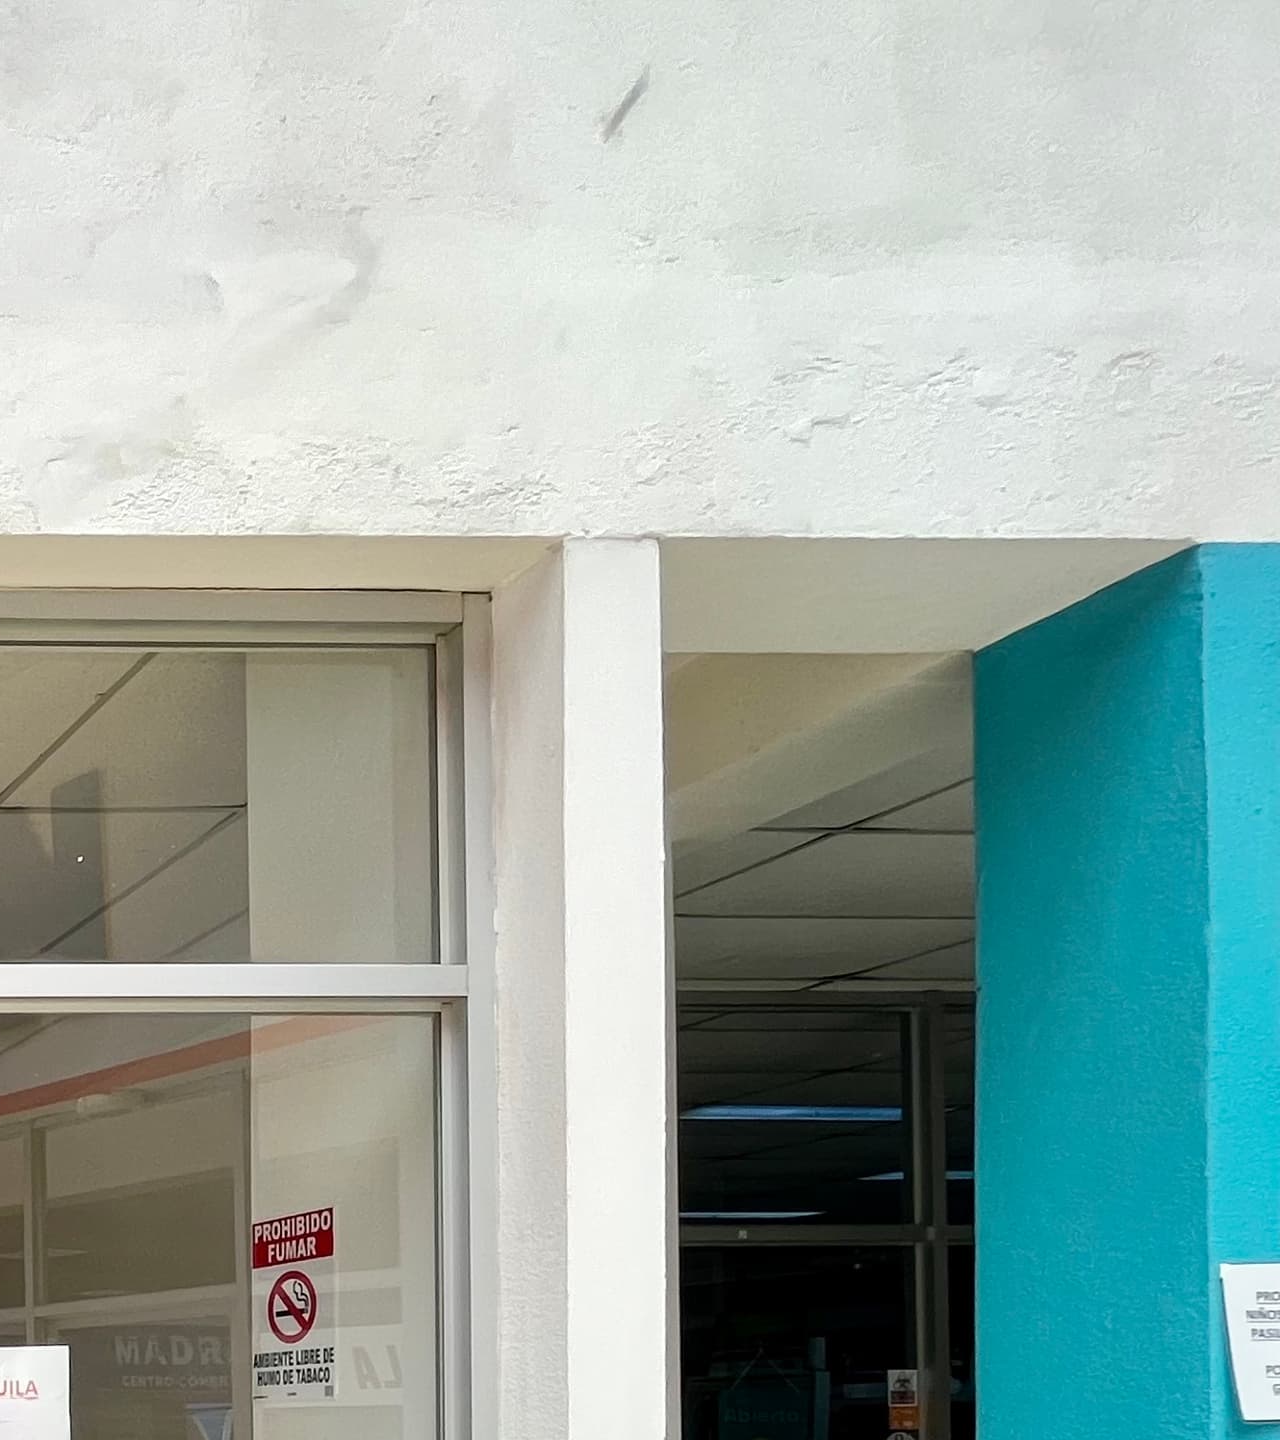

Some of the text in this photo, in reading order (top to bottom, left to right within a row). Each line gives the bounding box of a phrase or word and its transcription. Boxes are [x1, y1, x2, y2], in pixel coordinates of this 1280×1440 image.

[254, 1210, 331, 1243] PROHIBIDO
[267, 1236, 317, 1263] FUMAR
[253, 1347, 334, 1368] AMBIENTE LIBRE DE
[257, 1367, 331, 1386] HUMO DE TABACO
